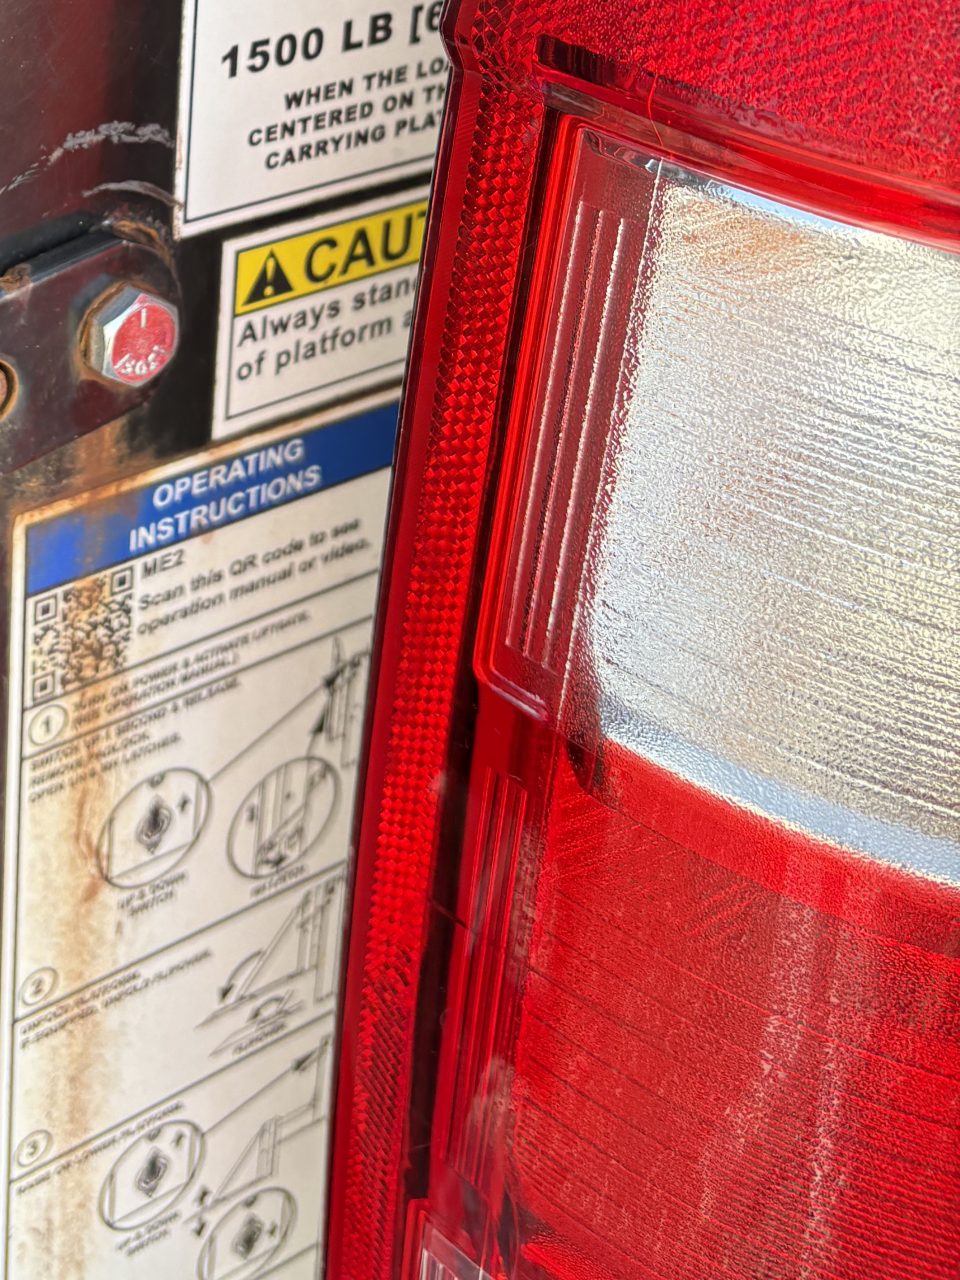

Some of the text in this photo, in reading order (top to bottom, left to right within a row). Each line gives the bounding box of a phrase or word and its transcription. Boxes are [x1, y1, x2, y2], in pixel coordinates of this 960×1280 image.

[220, 26, 324, 80] 1500
[341, 11, 394, 53] LB
[247, 101, 374, 148] CENTERED
[382, 89, 414, 113] ON
[284, 57, 450, 111] WHEN THE LO
[265, 109, 442, 170] CARRYING PLA
[305, 212, 426, 283] CAU
[237, 276, 417, 348] Always stan
[235, 350, 267, 382] of
[275, 316, 392, 376] platform
[129, 465, 321, 552] INSTRUCTIONS
[152, 438, 305, 509] OPERATING
[137, 537, 371, 635] operation manual or video.
[139, 519, 360, 610] Scan this QR code to see
